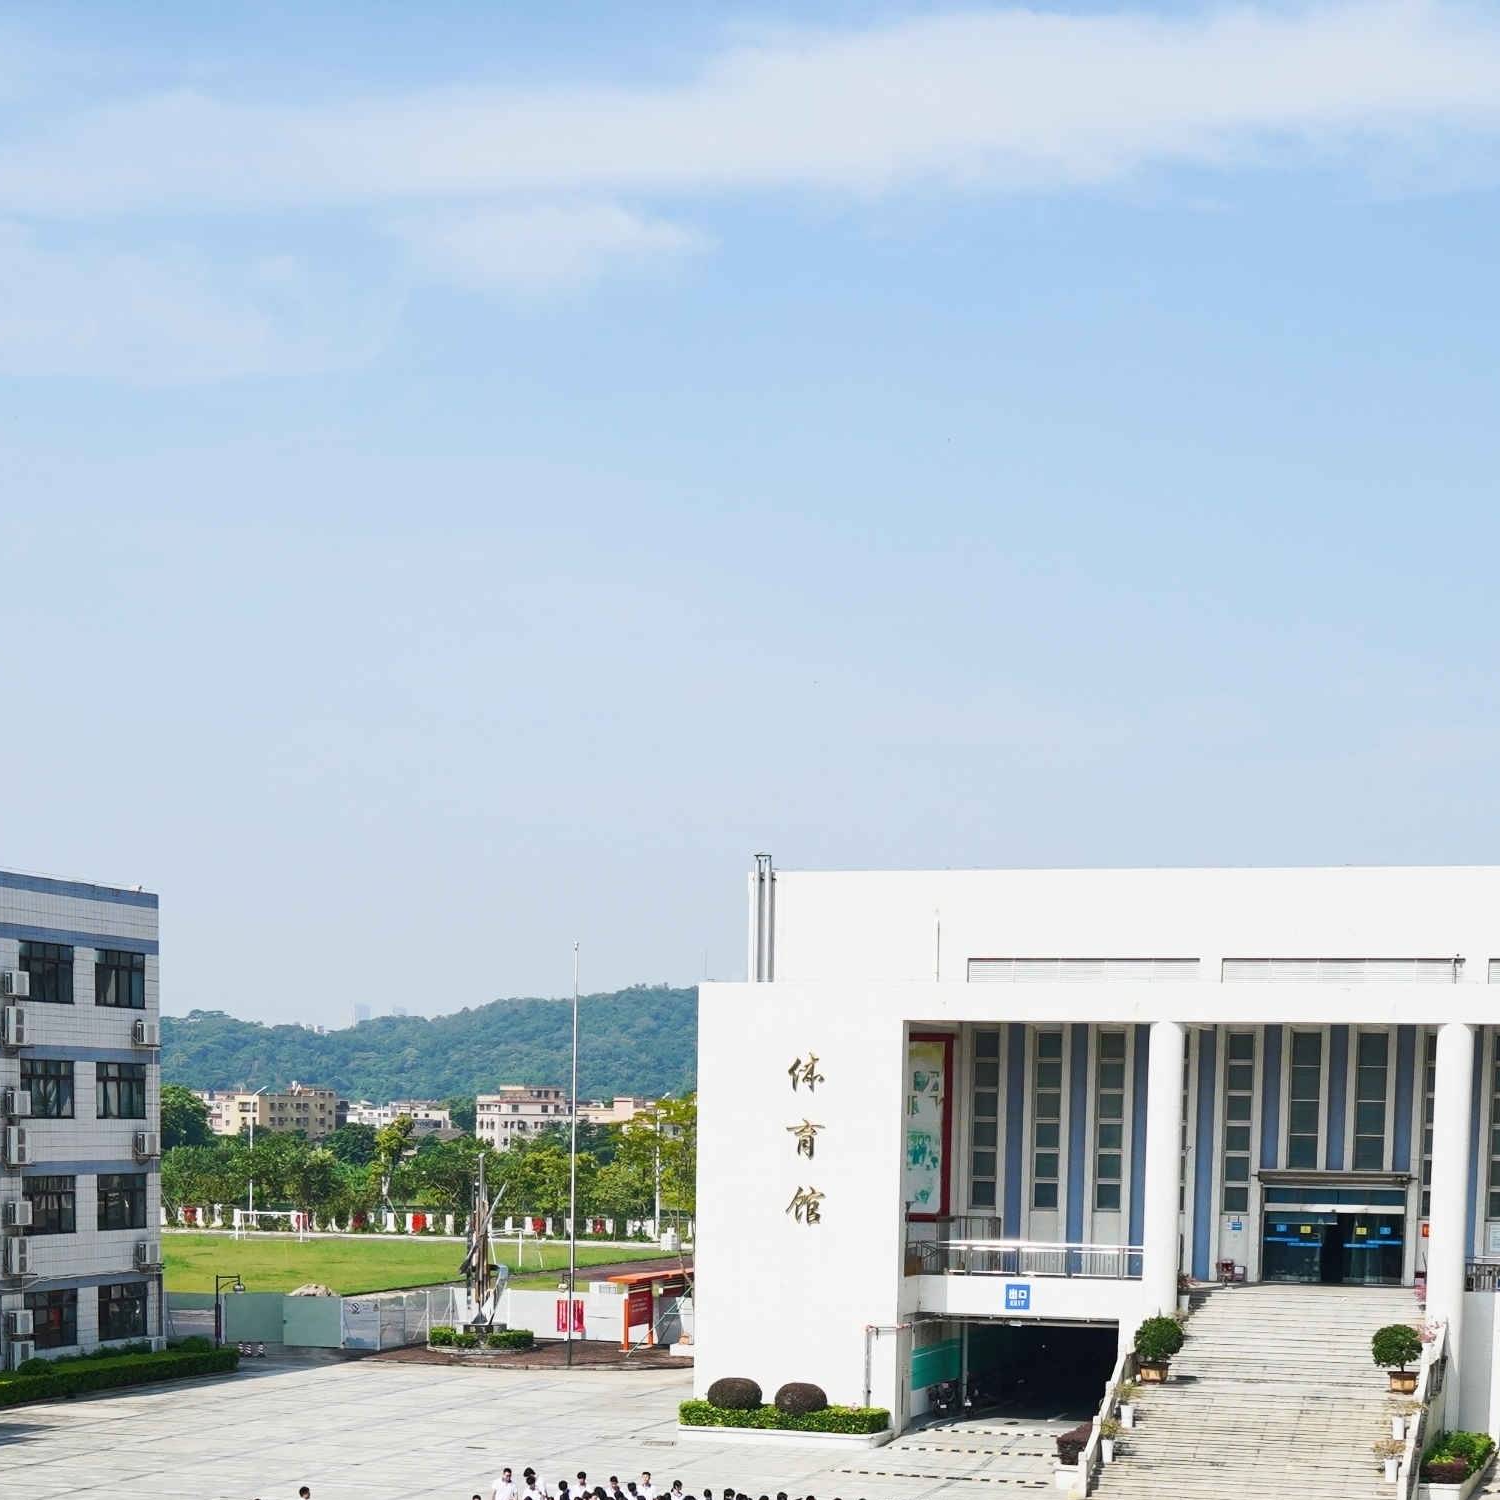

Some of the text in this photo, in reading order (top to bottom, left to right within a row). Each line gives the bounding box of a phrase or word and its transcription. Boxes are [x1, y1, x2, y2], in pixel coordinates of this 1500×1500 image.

[787, 1052, 826, 1227] 体育馆
[1008, 1288, 1028, 1300] 出口
